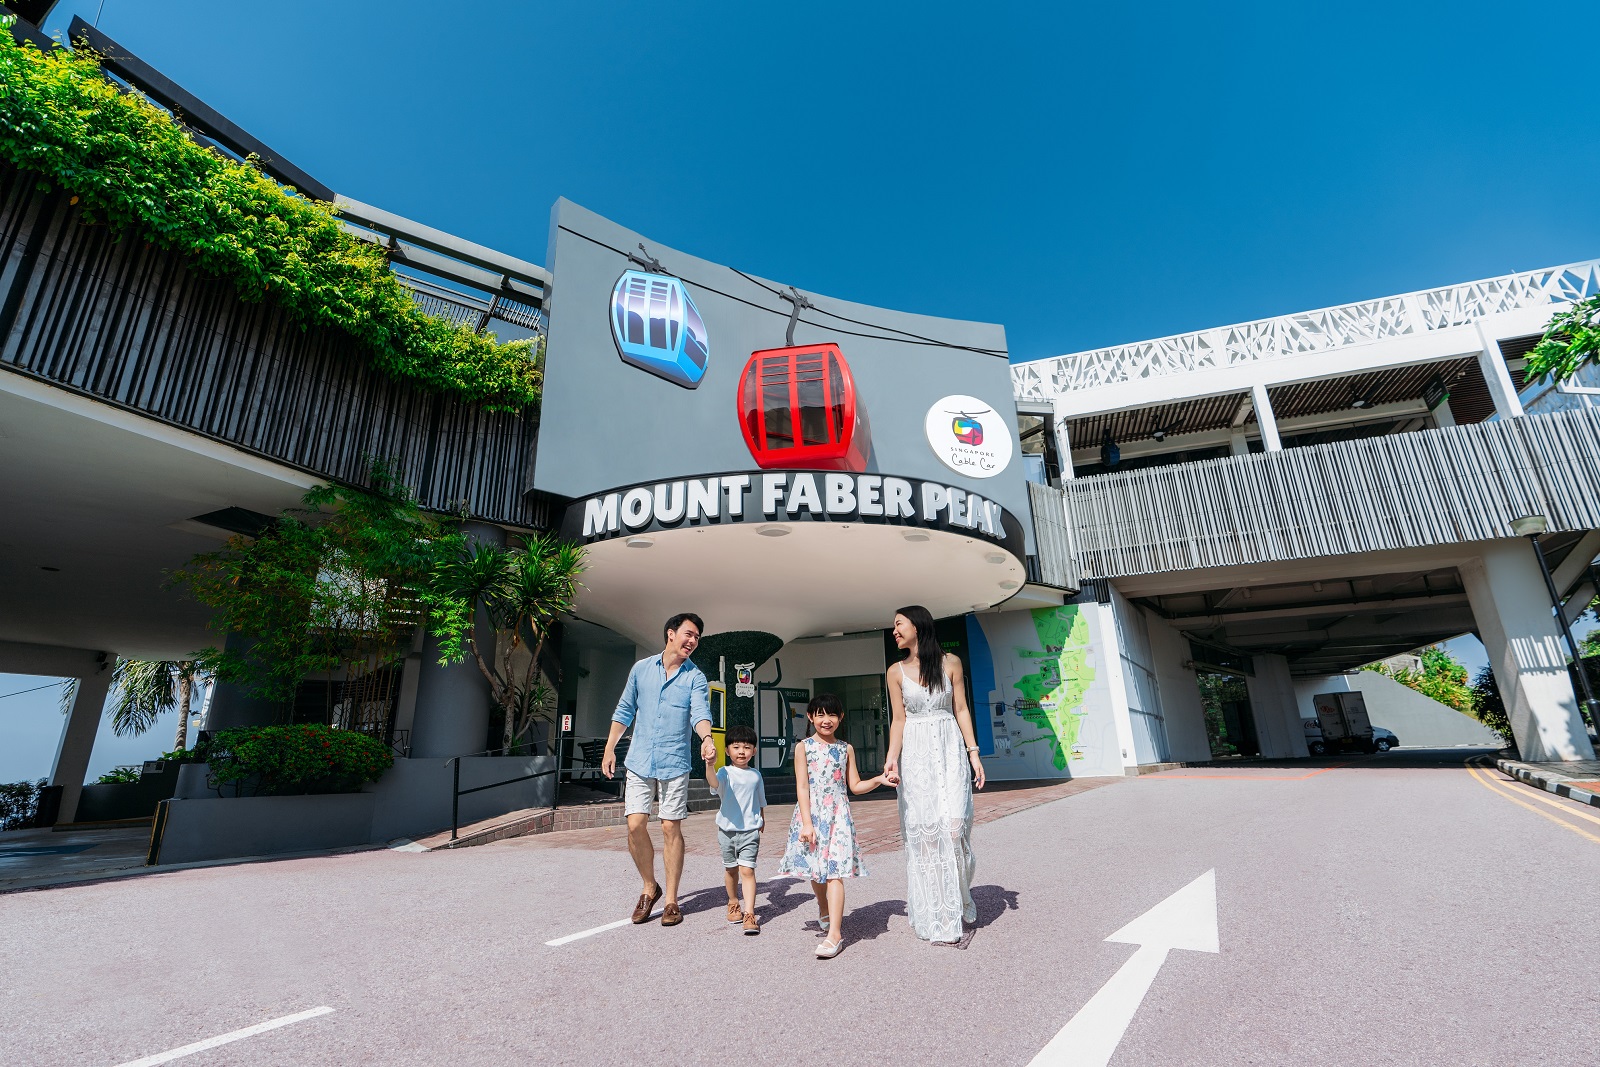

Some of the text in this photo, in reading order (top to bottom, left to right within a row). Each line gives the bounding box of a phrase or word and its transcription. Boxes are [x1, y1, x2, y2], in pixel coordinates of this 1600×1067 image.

[950, 447, 995, 457] SINGAPORE
[952, 453, 995, 470] Cable Car
[582, 472, 1007, 540] MOUNT FABER PEAK
[777, 738, 786, 746] 09
